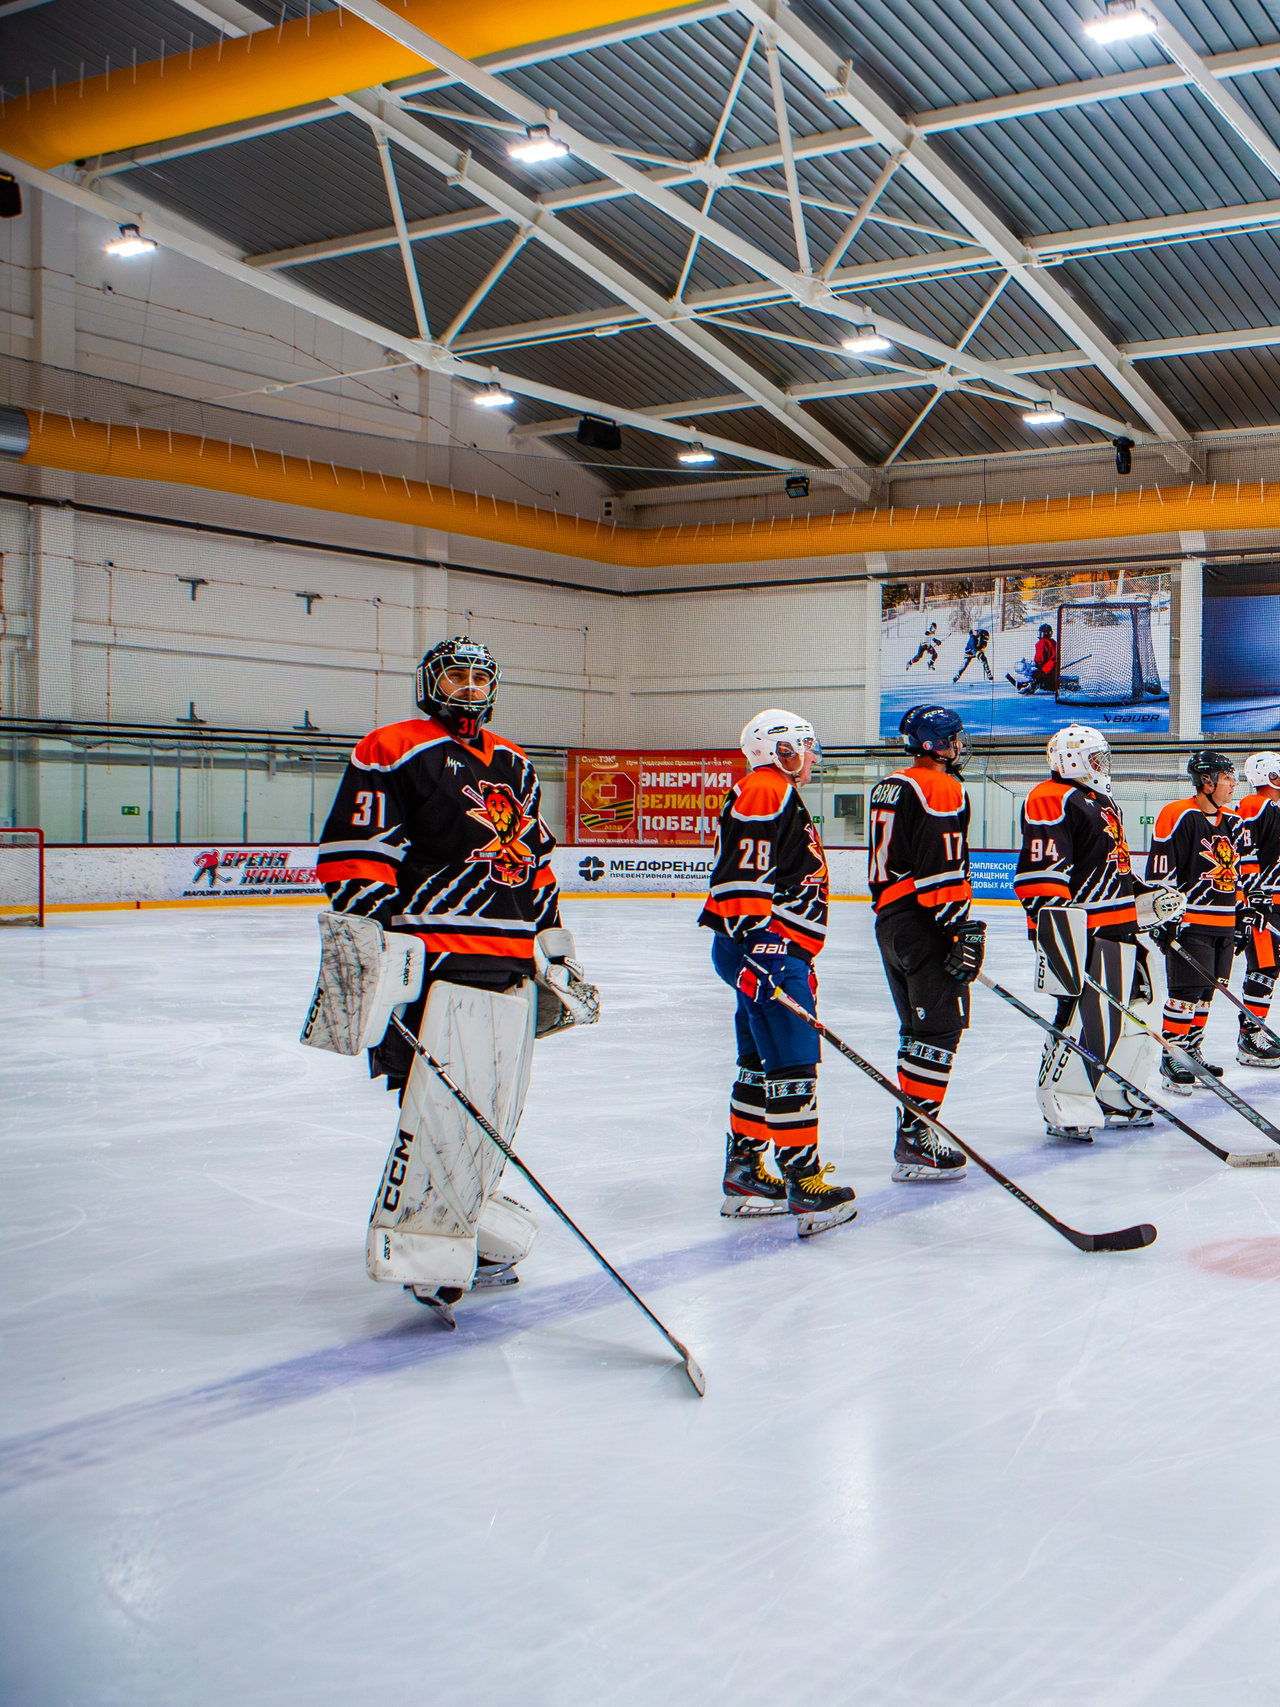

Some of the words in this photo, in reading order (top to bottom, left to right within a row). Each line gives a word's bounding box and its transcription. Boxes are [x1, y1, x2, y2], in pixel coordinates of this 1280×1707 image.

[458, 717, 476, 736] 31
[1112, 713, 1160, 723] BAUER
[638, 772, 732, 788] ЭНЕРГИЯ
[352, 790, 386, 828] 31
[738, 838, 771, 871] 28
[943, 832, 963, 861] 17
[1031, 839, 1059, 862] 94
[221, 851, 290, 867] ВРЕМЯ
[969, 862, 1017, 870] ОМПЛЕКСНОЕ
[1153, 855, 1168, 873] 10
[240, 868, 317, 885] ХОККЕЯ
[609, 872, 672, 880] ПРЕВЕНТИВНАЯ
[971, 871, 1009, 880] СНАЩЕНИЕ
[182, 889, 221, 897] МАГАЗИН
[273, 887, 325, 895] ЭКИПИРОВК
[971, 881, 998, 889] ЕДОВЫХ
[1000, 882, 1014, 890] АРЕ
[751, 943, 788, 955] BAU
[1037, 955, 1047, 989] CCM
[304, 987, 324, 1040] CCM
[1199, 1074, 1273, 1131] BAUER
[382, 1128, 415, 1213] CCM
